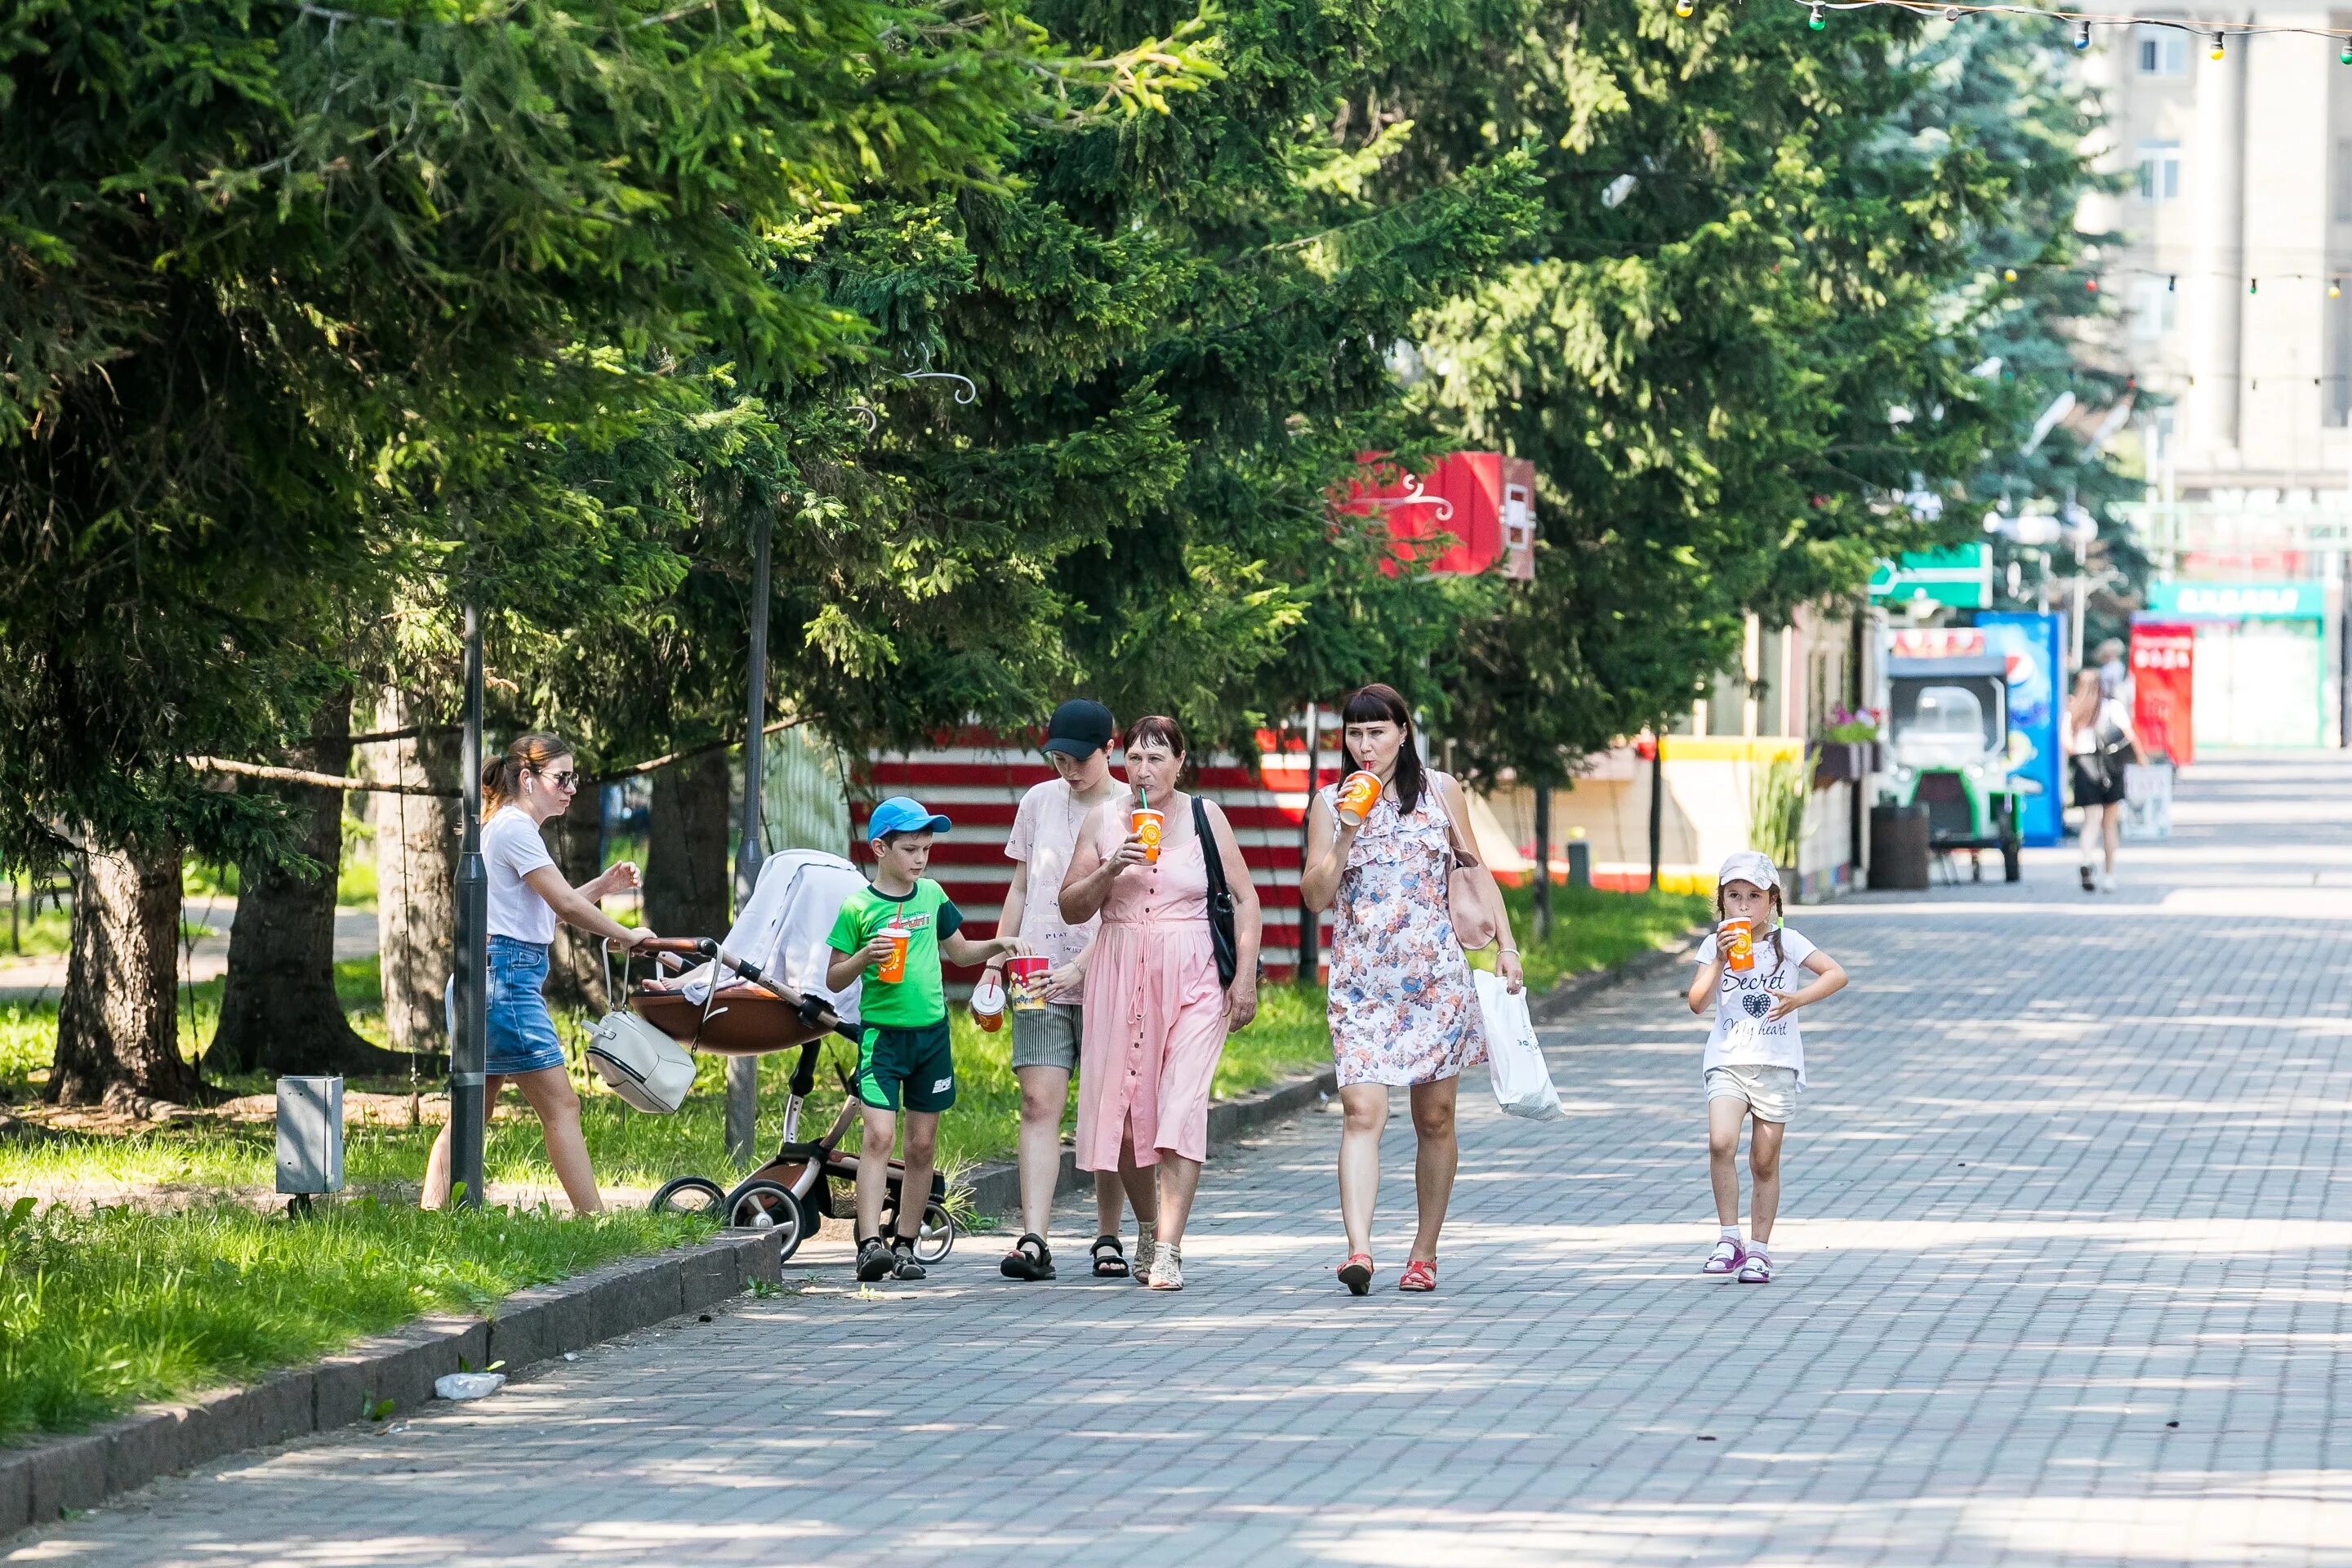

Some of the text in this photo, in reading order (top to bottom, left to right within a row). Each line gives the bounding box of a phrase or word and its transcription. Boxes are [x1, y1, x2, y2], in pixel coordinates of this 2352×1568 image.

[1722, 967, 1786, 992] Secret
[1722, 1018, 1788, 1045] My heart
